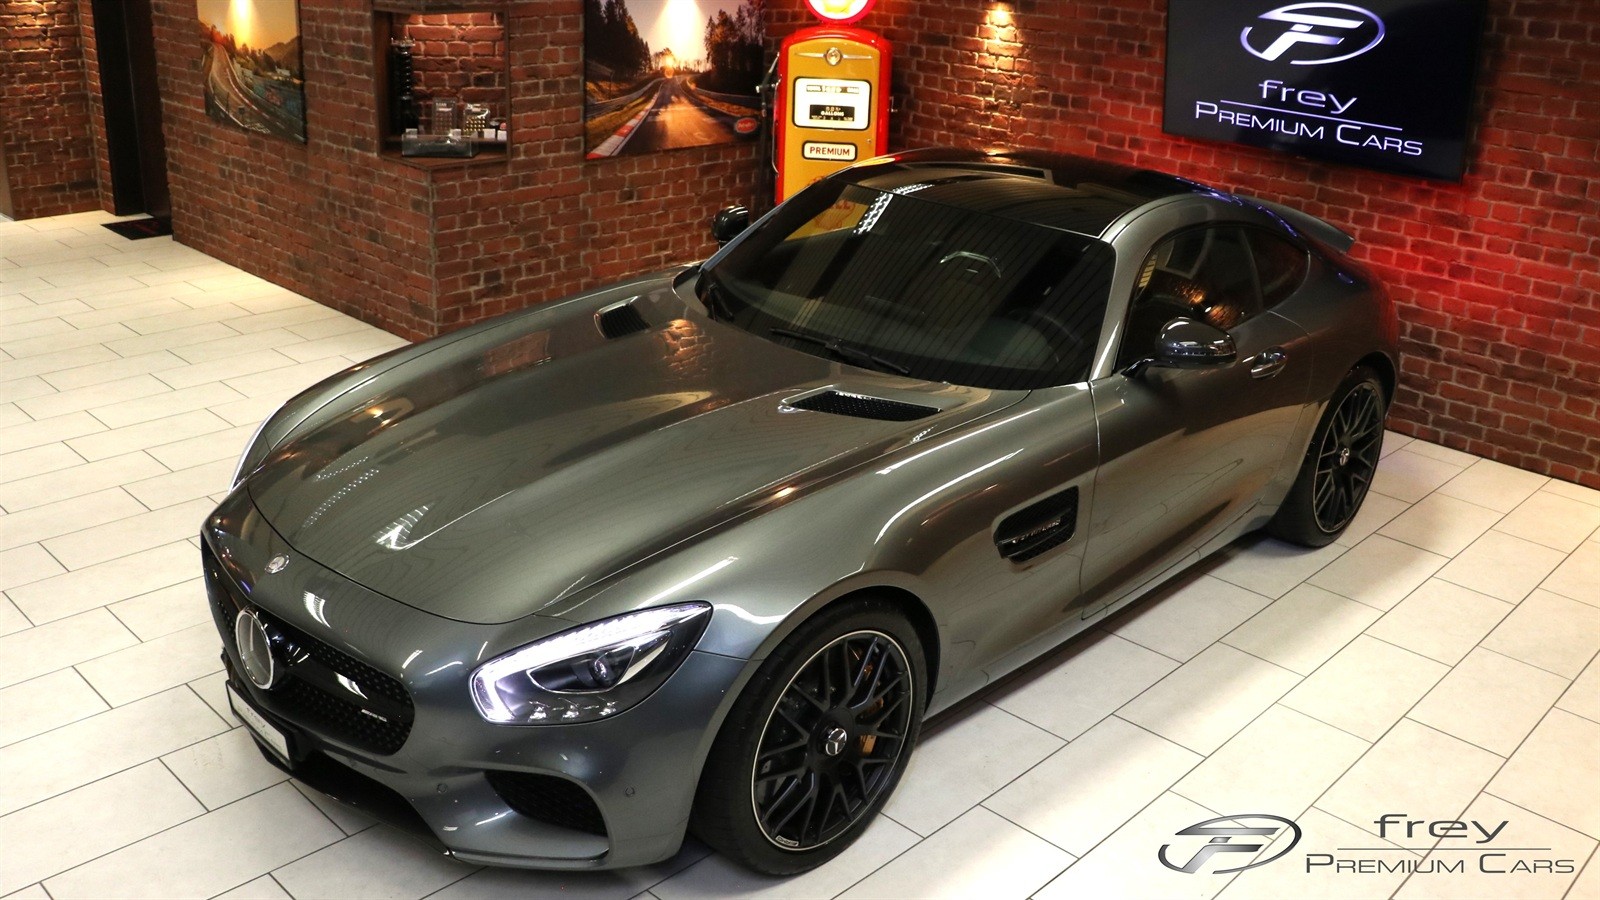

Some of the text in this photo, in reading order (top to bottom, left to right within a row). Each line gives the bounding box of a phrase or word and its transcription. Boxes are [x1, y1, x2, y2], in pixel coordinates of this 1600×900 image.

[1258, 79, 1358, 114] frey
[1195, 100, 1423, 156] PREMIUM CARS
[809, 146, 851, 156] PREMIUM
